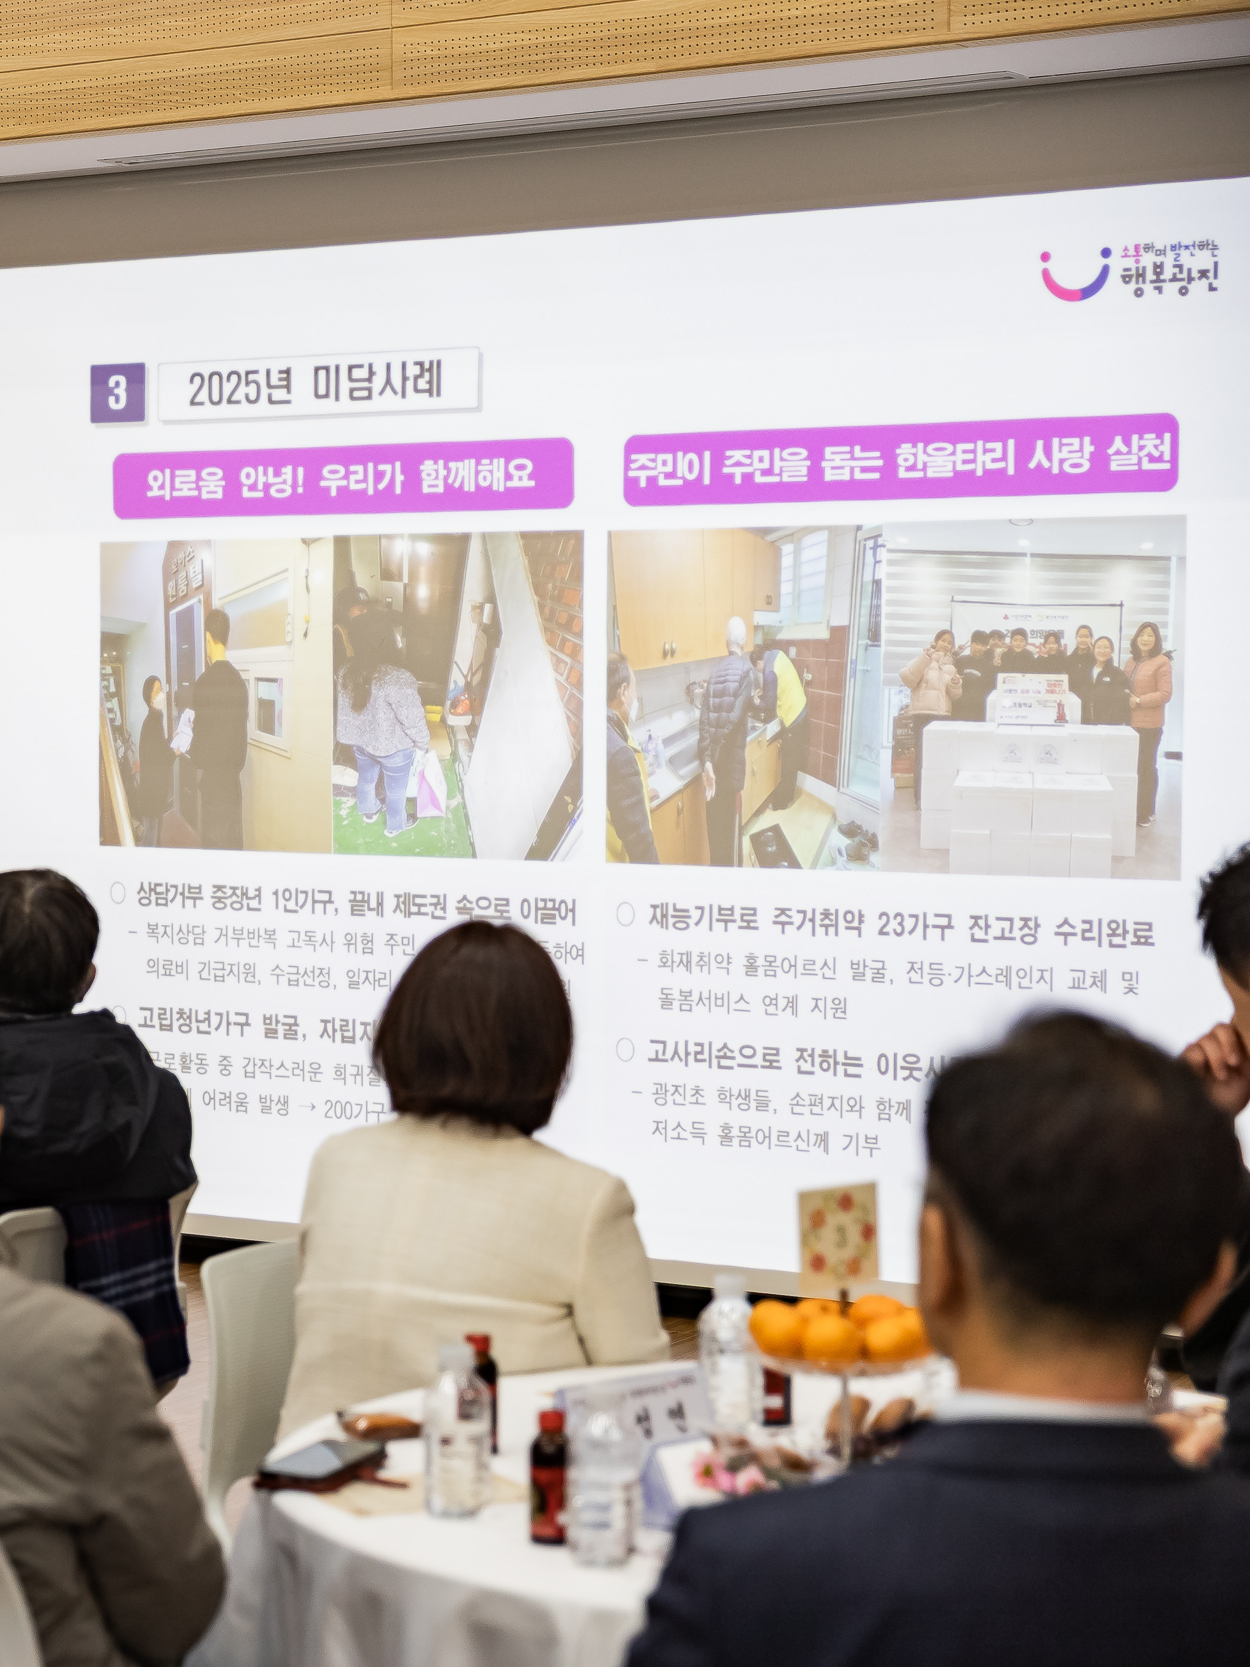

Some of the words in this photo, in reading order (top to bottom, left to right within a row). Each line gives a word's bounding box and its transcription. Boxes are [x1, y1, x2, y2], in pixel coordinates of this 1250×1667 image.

[1121, 242, 1167, 265] 소통하며
[1170, 239, 1219, 262] 발전하는
[1120, 261, 1218, 298] 행복광진
[108, 375, 126, 410] 3
[189, 367, 292, 406] 2025년
[314, 359, 442, 402] 미담사례
[628, 451, 710, 487] 주민이
[722, 448, 811, 484] 주민을
[821, 445, 883, 481] 돕는
[896, 439, 1015, 478] 한울타리
[1028, 437, 1094, 474] 사랑
[1107, 433, 1171, 471] 실천
[147, 467, 225, 500] 외로움
[240, 465, 304, 498] 안녕!
[320, 461, 404, 496] 우리가
[420, 458, 535, 493] 함께해요
[137, 882, 204, 907] 상담거부
[211, 885, 261, 912] 중장년
[272, 888, 338, 916] 1인가구,
[348, 891, 384, 918] 끝내
[393, 892, 446, 920] 제도권
[455, 895, 511, 921] 속으로
[521, 897, 576, 926] 이끌어
[146, 922, 206, 946] 복지상담
[215, 925, 277, 949] 거부반복
[287, 930, 335, 952] 고독사
[343, 932, 373, 955] 위험
[384, 933, 415, 956] 주민
[539, 938, 584, 965] 하여
[649, 902, 759, 932] 재능기부로
[772, 907, 865, 938] 주거취약
[878, 912, 954, 941] 23가구
[969, 914, 1041, 945] 잔고장
[1054, 917, 1155, 948] 수리완료
[147, 958, 188, 980] 의료비
[198, 960, 260, 985] 긴급지원,
[270, 964, 336, 990] 수급선정,
[346, 968, 392, 992] 일자리
[658, 950, 732, 975] 화재취약
[743, 953, 836, 980] 홀몸어르신
[851, 959, 893, 985] 발굴,
[1068, 969, 1107, 994] 교체
[1122, 971, 1138, 995] 및
[659, 988, 750, 1014] 돌봄서비스
[762, 993, 798, 1018] 연계
[811, 996, 847, 1020] 지원
[138, 1007, 251, 1037] 고립청년가구
[263, 1014, 306, 1041] 발굴,
[218, 1056, 233, 1076] 중
[243, 1057, 323, 1082] 갑작스러운
[648, 1040, 782, 1070] 고사리손으로
[795, 1048, 863, 1078] 전하는
[203, 1089, 249, 1114] 어려움
[259, 1094, 288, 1116] 발생
[652, 1083, 706, 1106] 광진초
[717, 1087, 776, 1114] 학생들,
[789, 1092, 865, 1119] 손편지와
[876, 1097, 911, 1124] 함께
[652, 1120, 707, 1145] 저소득
[718, 1123, 829, 1155] 홀몸어르신께
[843, 1133, 881, 1157] 기부
